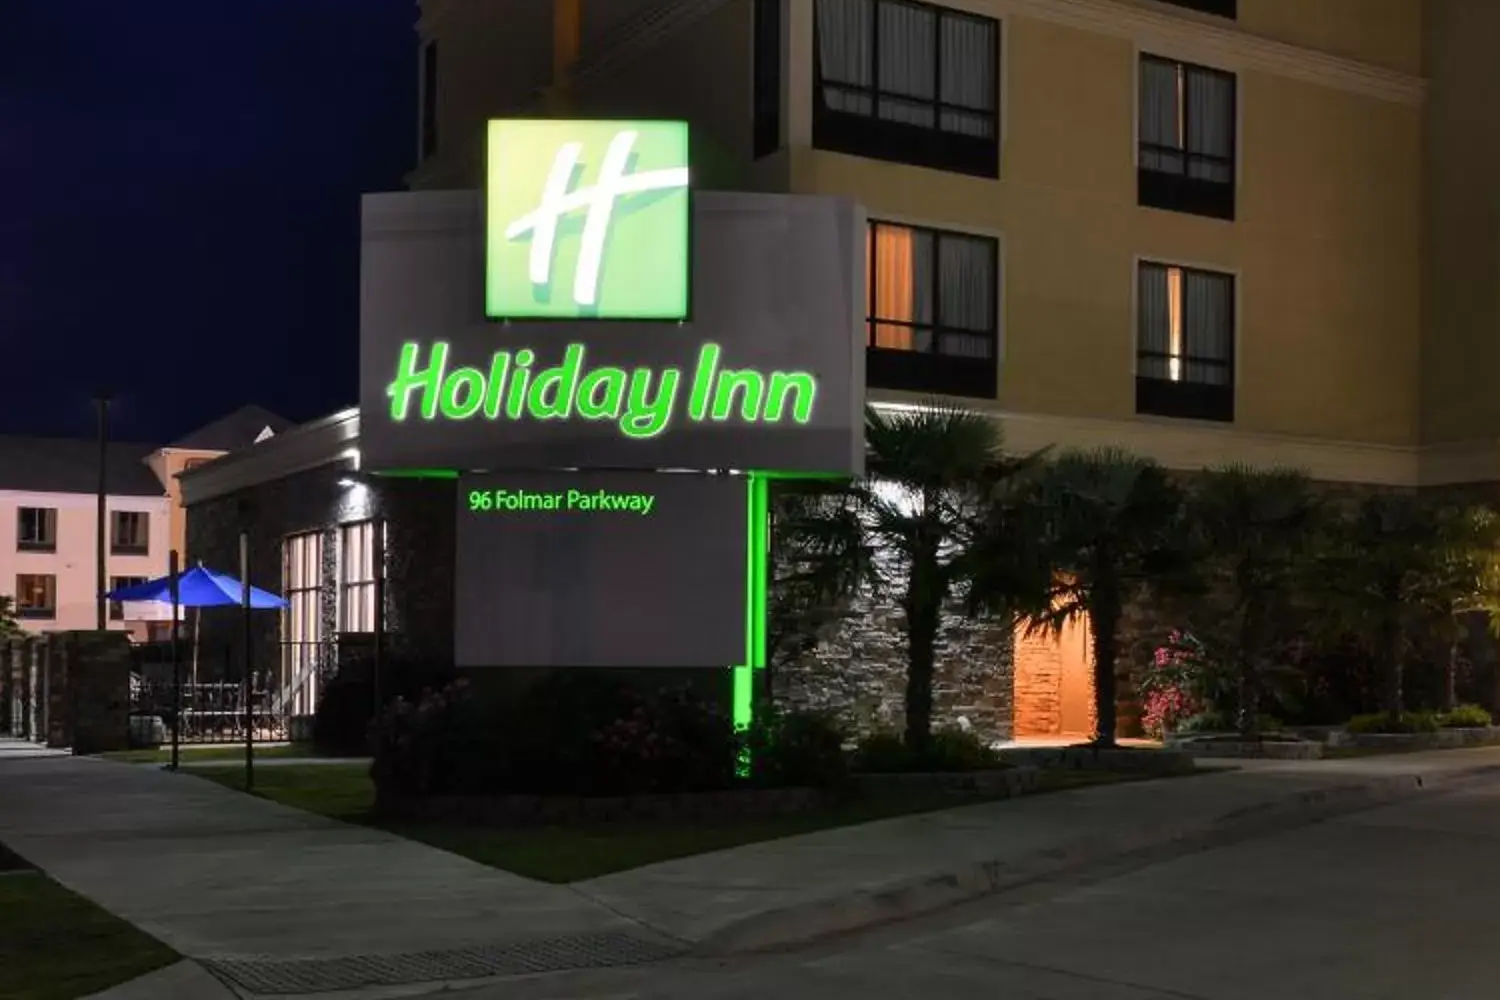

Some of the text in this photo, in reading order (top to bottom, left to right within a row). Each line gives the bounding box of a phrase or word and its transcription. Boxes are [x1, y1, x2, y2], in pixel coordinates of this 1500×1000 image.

[387, 341, 816, 439] Holiday Inn
[468, 488, 655, 515] 96 Folmar Parkway
